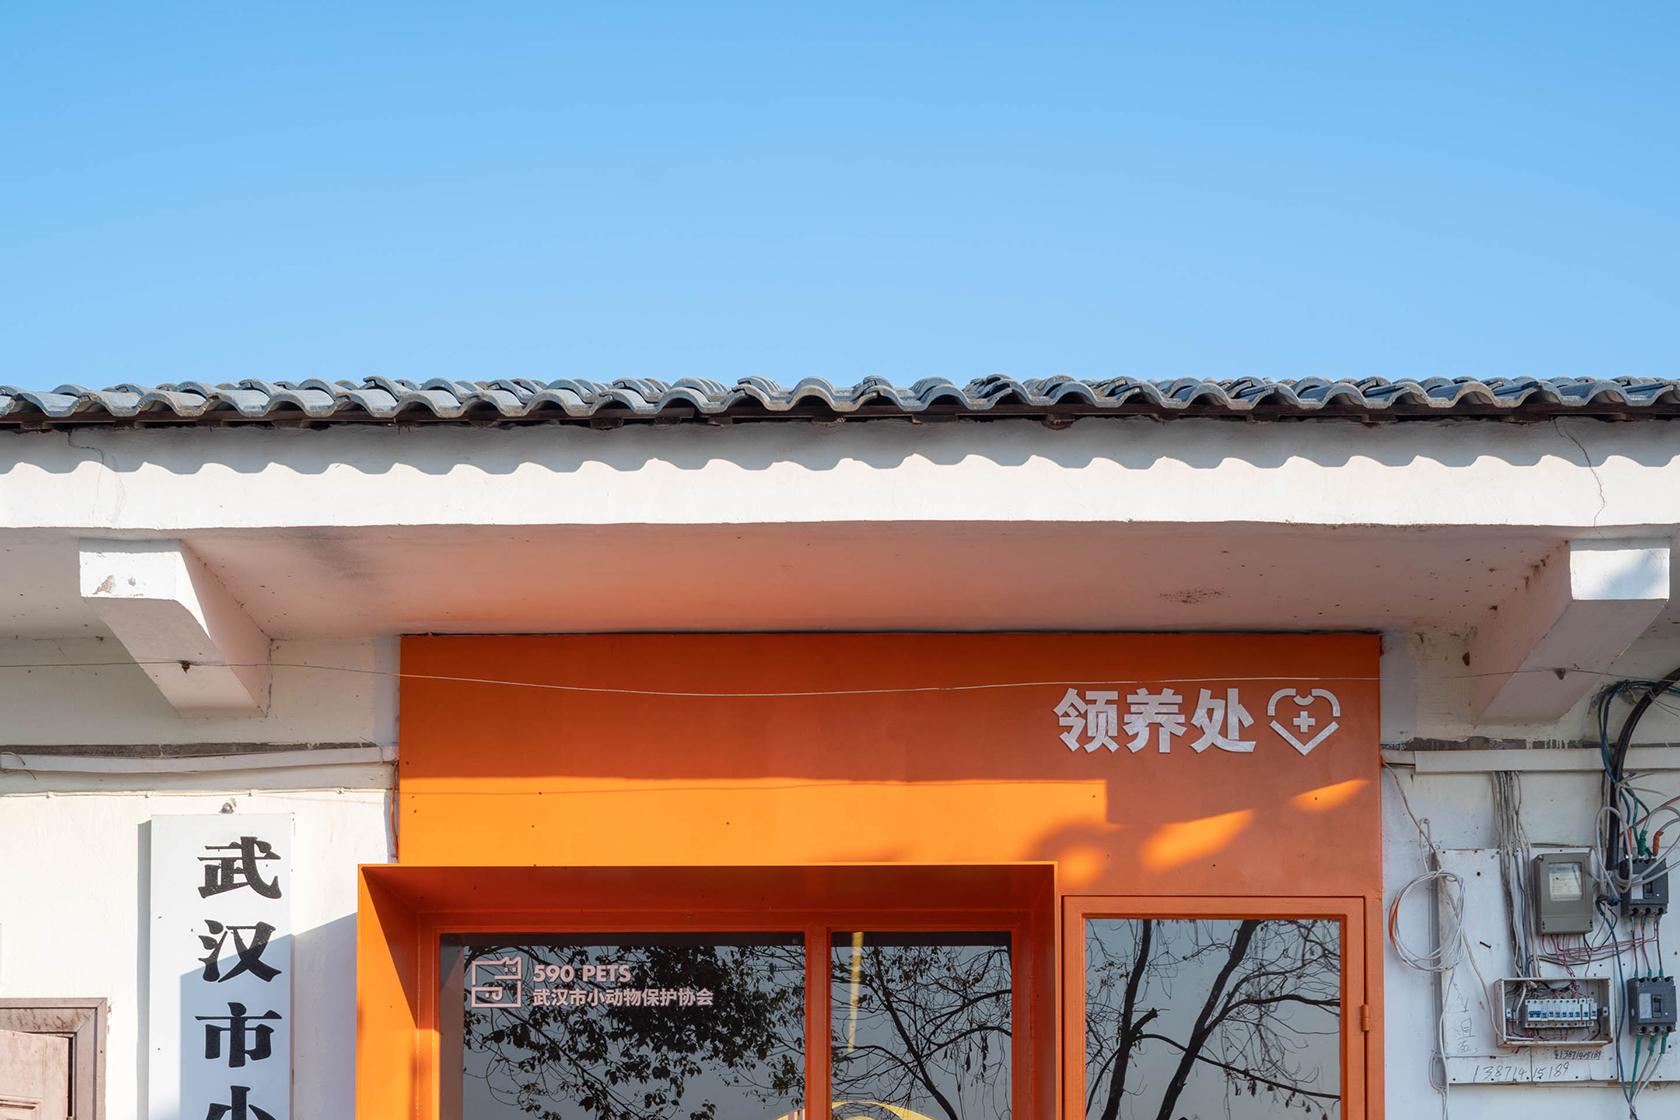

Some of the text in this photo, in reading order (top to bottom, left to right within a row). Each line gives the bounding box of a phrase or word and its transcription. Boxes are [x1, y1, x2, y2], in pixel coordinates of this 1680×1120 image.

[1053, 687, 1256, 753] 领养处
[533, 964, 632, 983] 590 PETS
[533, 988, 714, 1007] 武汉市小动物保护协会
